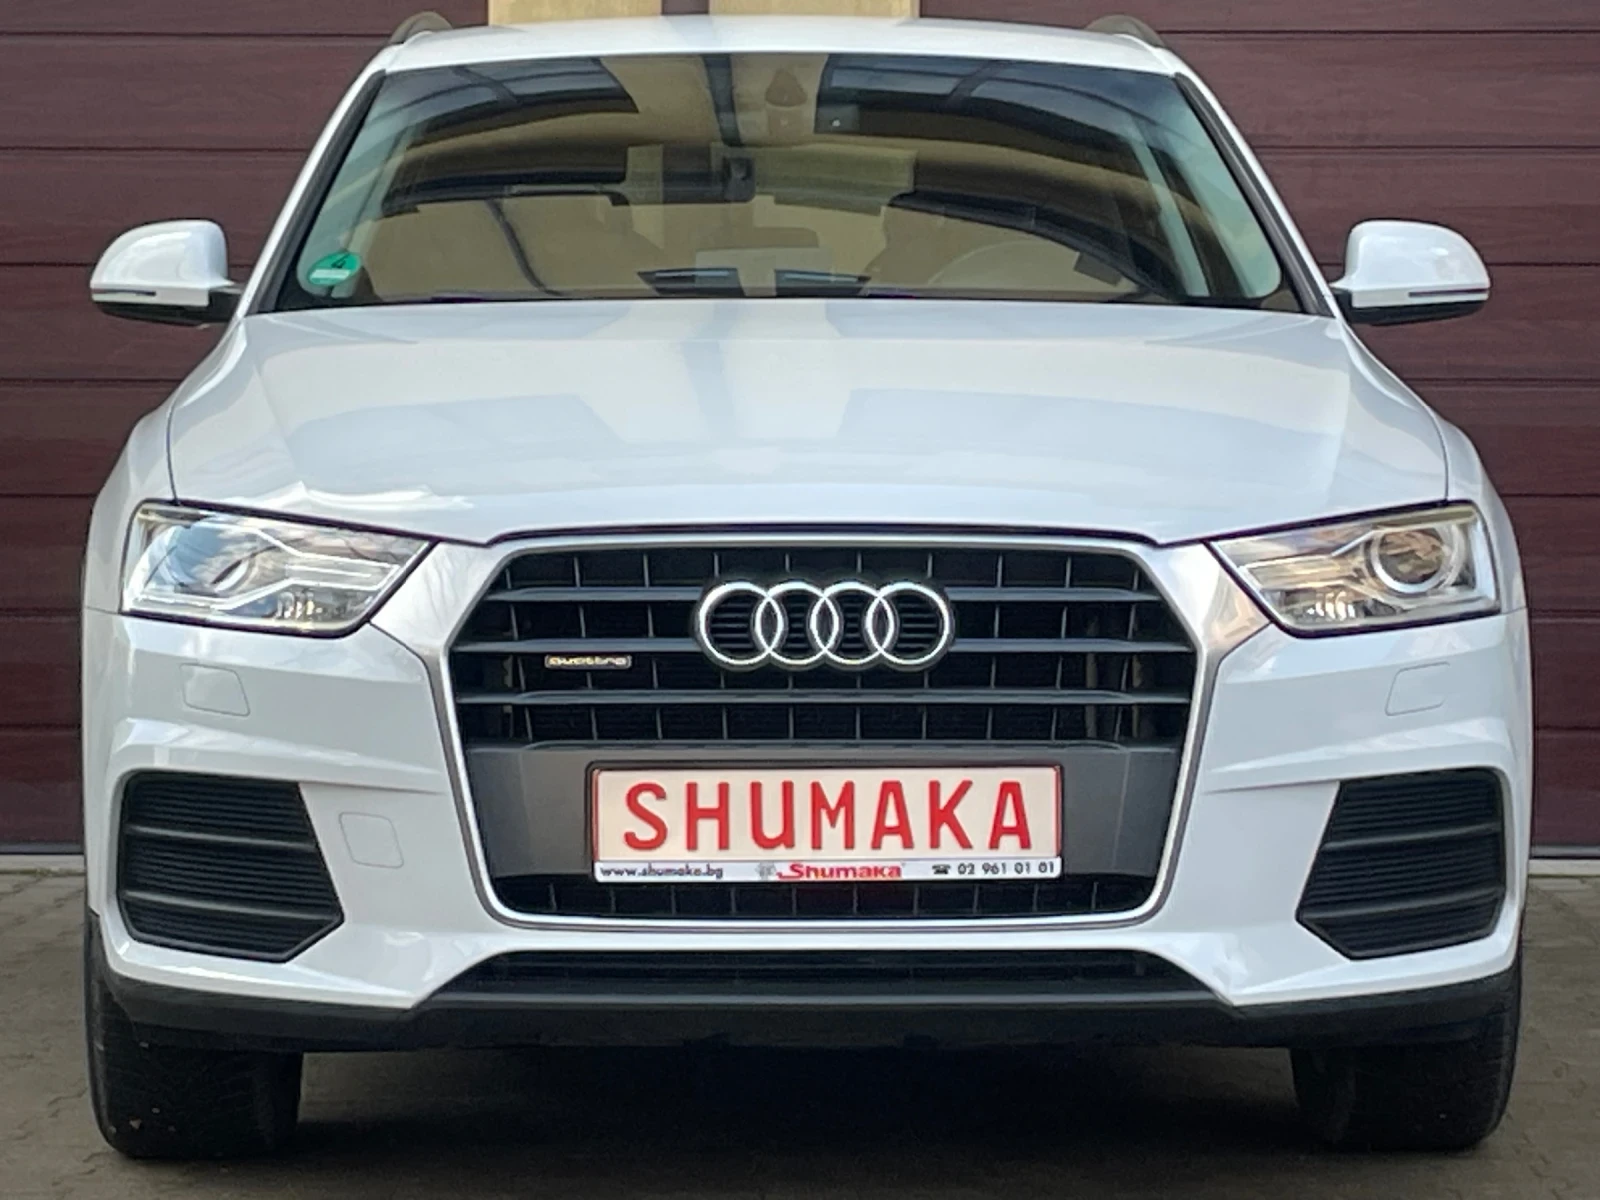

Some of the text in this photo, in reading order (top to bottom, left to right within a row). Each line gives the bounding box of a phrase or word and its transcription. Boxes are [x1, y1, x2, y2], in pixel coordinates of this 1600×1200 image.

[623, 780, 1032, 851] SHUMAKA
[600, 863, 724, 879] www.shumaka.bg
[777, 863, 902, 880] Shumaka
[957, 861, 1055, 875] 02 961 01 01
